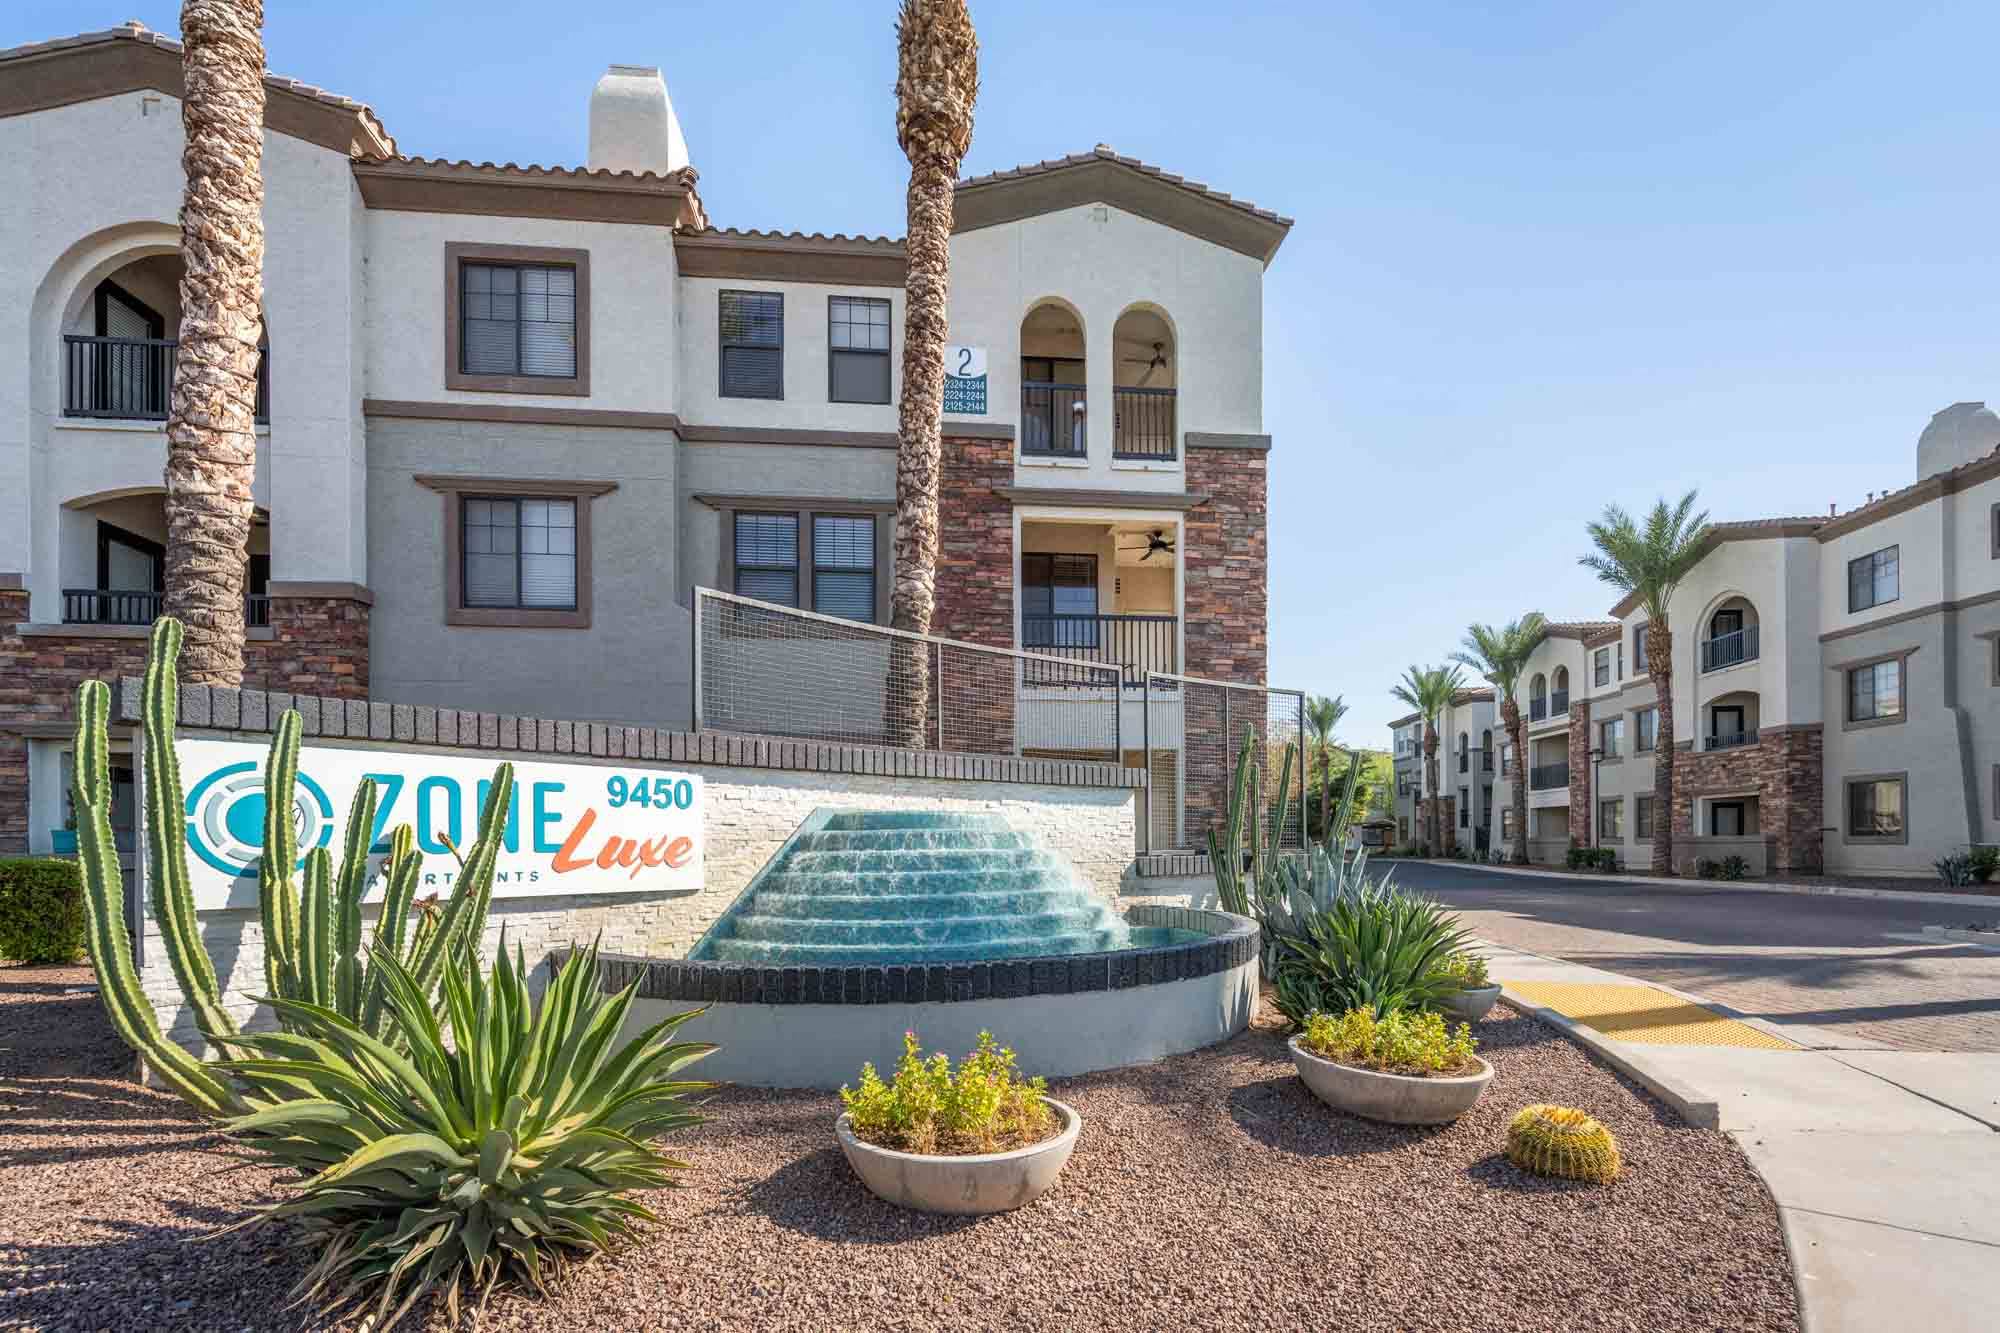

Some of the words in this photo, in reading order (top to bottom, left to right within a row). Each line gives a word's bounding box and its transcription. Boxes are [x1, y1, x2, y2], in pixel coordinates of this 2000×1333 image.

[959, 348, 972, 377] 2
[944, 390, 985, 401] 2224-2244
[944, 401, 985, 411] 2125-2144
[607, 775, 693, 810] 9450
[551, 807, 693, 880] Luxe
